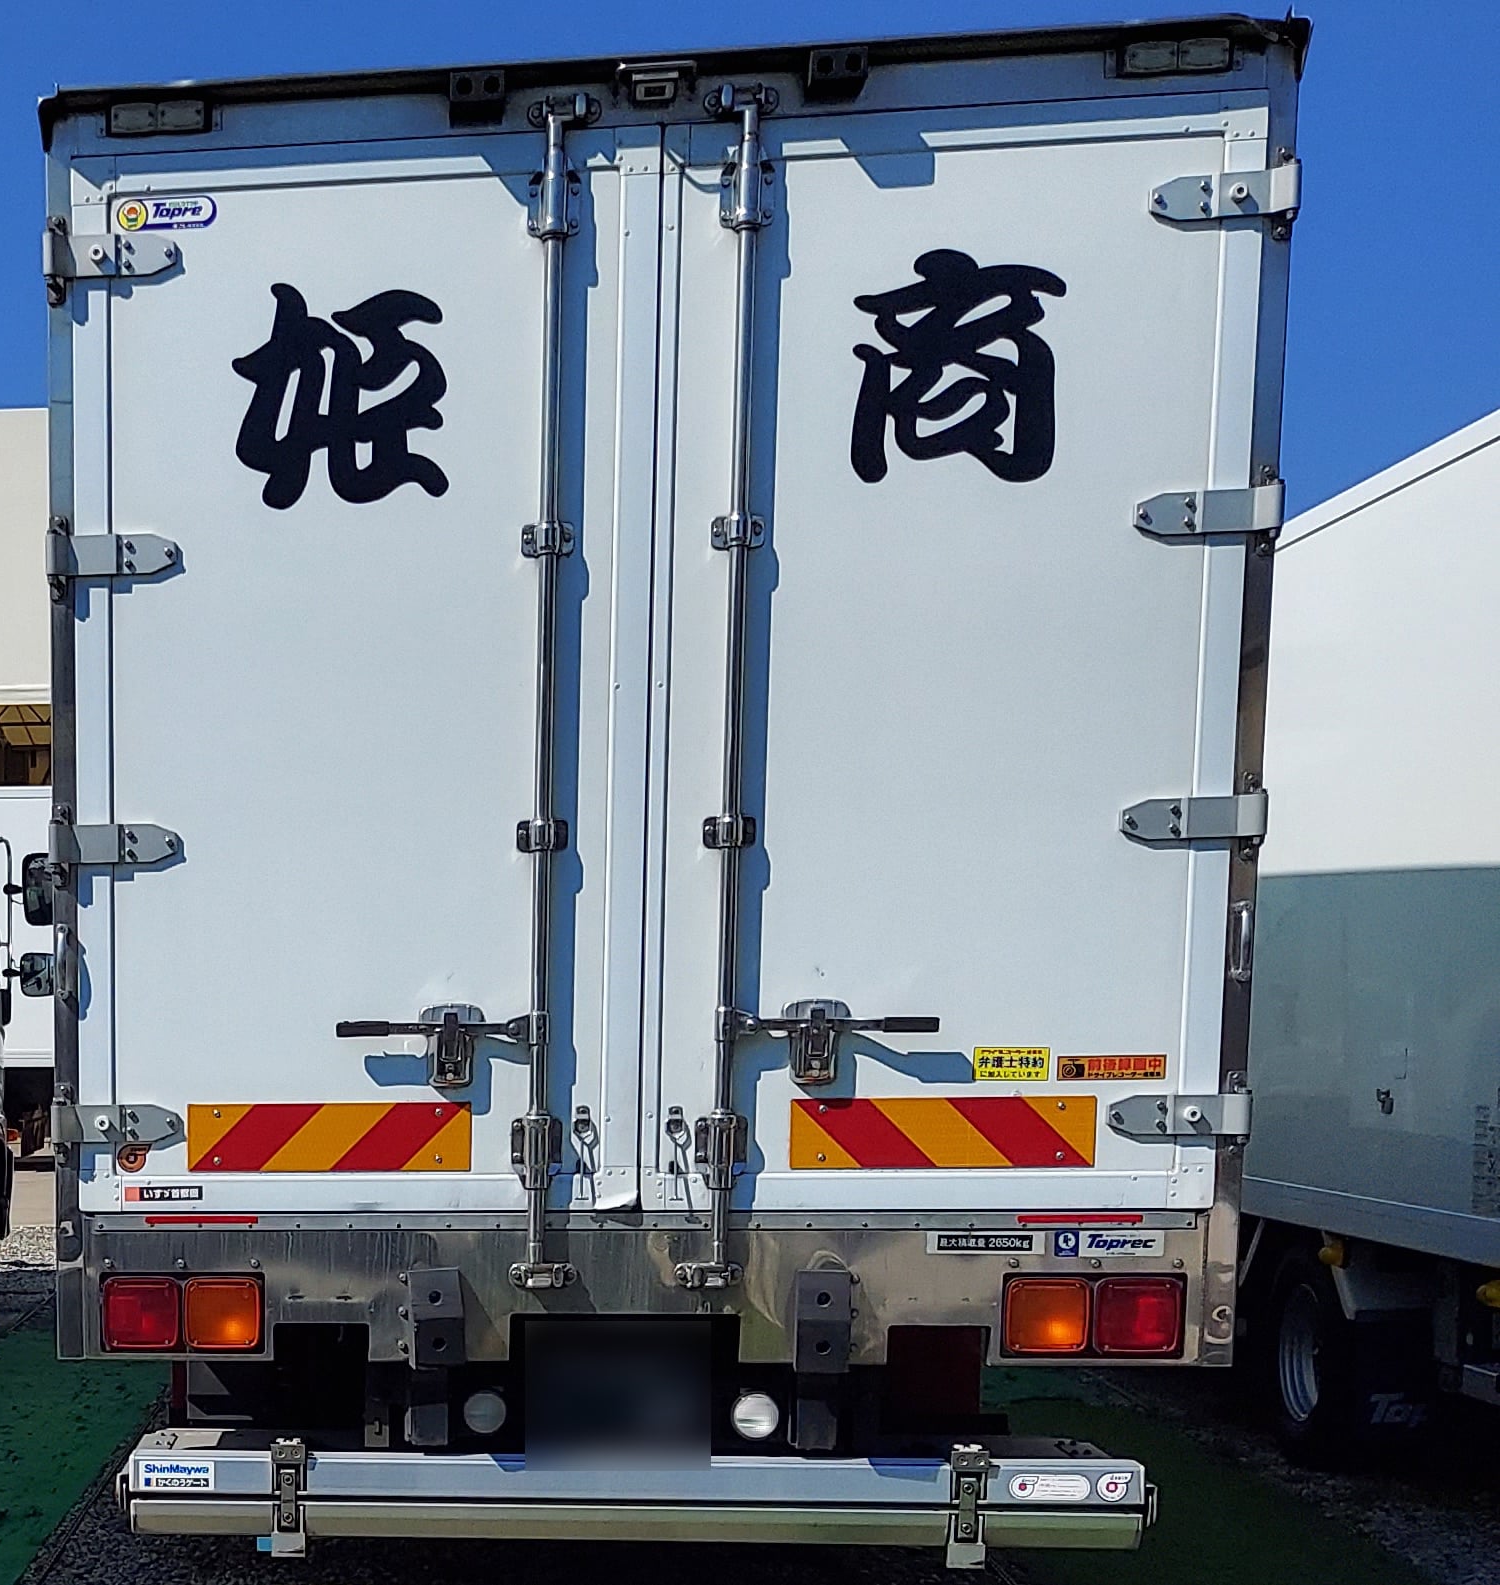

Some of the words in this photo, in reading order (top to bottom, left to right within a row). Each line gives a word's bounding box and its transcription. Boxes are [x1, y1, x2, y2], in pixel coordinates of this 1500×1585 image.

[153, 202, 203, 219] Topre
[851, 249, 1066, 483] 商
[978, 1055, 1044, 1069] 弁護士特約
[988, 1237, 1030, 1249] 2650kg
[1086, 1233, 1157, 1250] Toprec
[144, 1463, 209, 1475] ShinMaywa
